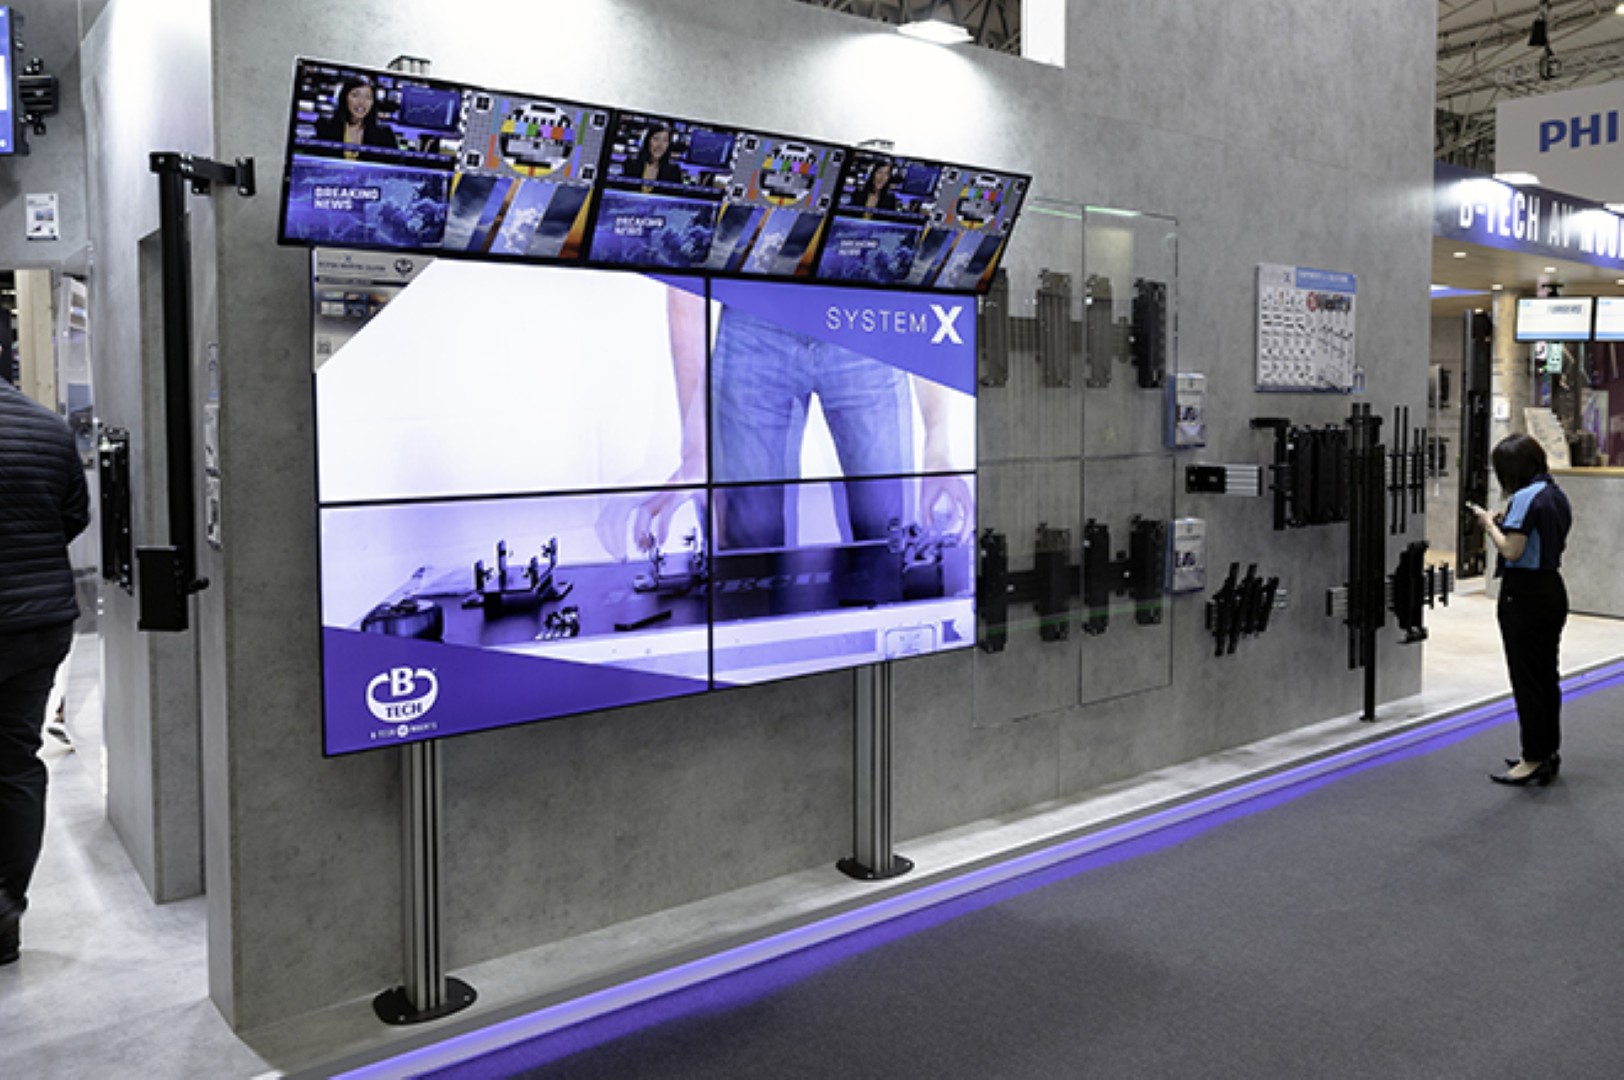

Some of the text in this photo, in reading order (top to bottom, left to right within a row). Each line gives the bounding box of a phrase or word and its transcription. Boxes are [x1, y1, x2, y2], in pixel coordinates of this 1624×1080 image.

[1539, 110, 1619, 153] PHI
[825, 303, 965, 345] SYSTEM X
[390, 667, 416, 697] B
[386, 702, 424, 718] TECH
